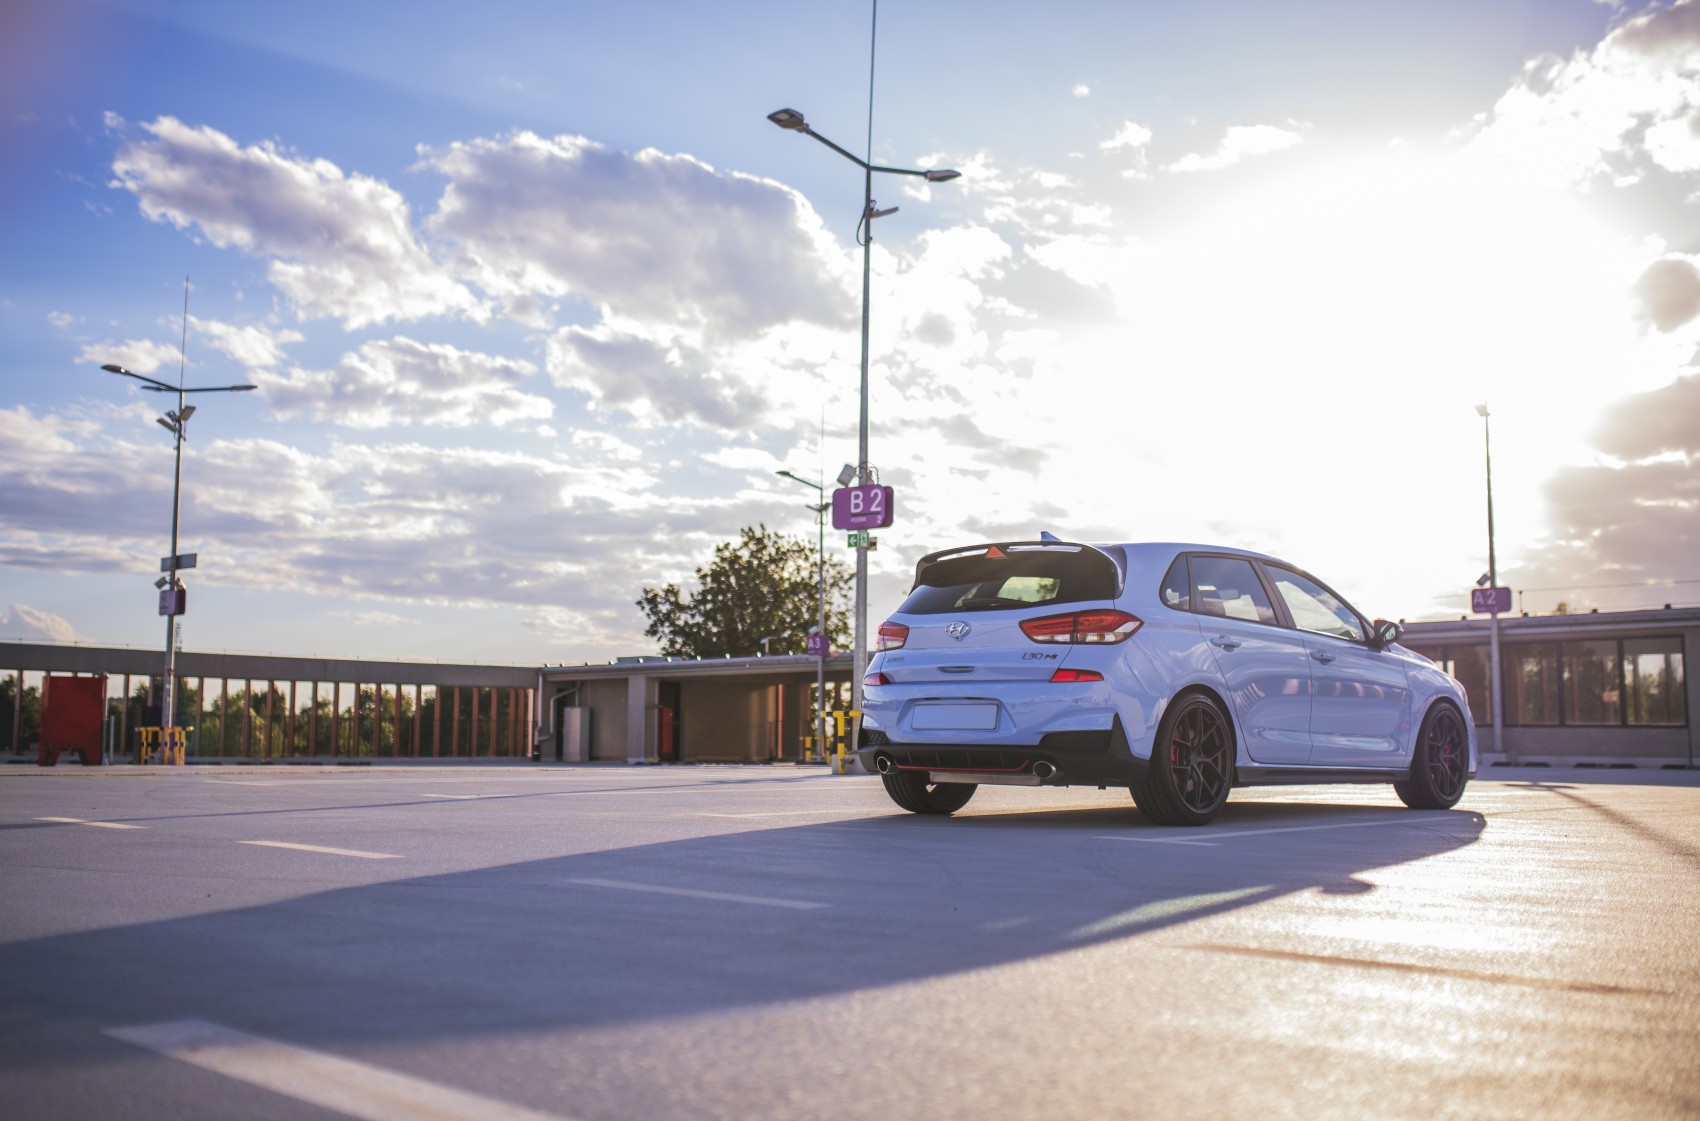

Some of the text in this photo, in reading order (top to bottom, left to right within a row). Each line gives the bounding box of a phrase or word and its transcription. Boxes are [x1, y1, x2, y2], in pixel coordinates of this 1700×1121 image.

[851, 489, 882, 513] B 2
[1474, 590, 1496, 605] A 2
[808, 637, 821, 648] A 3
